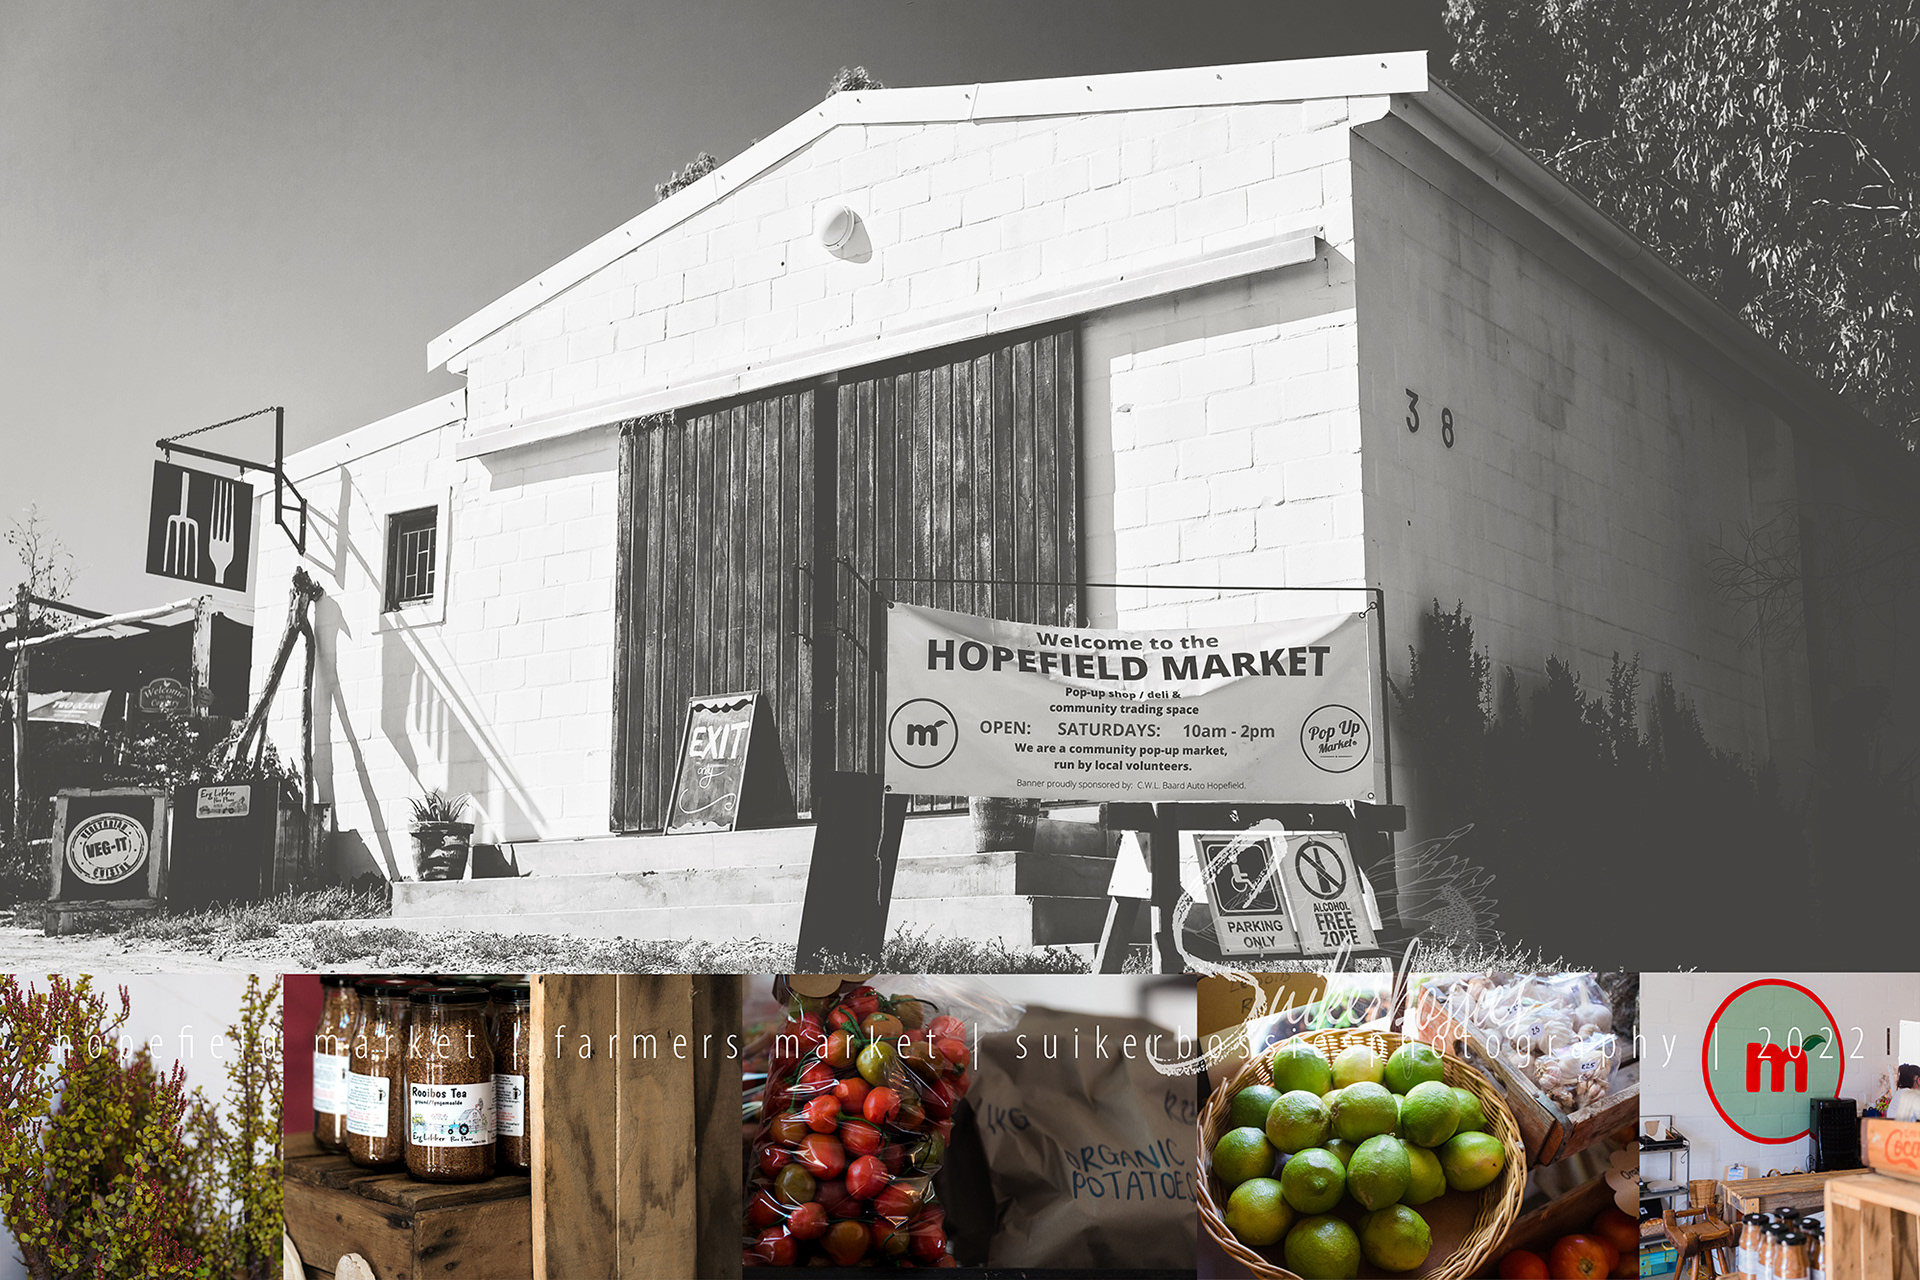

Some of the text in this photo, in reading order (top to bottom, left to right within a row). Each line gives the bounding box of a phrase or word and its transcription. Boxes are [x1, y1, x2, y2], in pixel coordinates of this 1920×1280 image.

[1036, 632, 1219, 650] Welcome to the
[927, 639, 1331, 681] HOPEFIELD MARKET
[144, 686, 186, 698] Welcome
[1065, 687, 1105, 699] Pop-up
[1108, 690, 1136, 700] shop
[1147, 690, 1169, 699] deli
[1172, 690, 1181, 699] &
[1050, 703, 1199, 716] community trading space
[980, 720, 1031, 735] OPEN:
[1058, 722, 1161, 738] SATURDAYS:
[1183, 724, 1227, 738] 10am
[1240, 724, 1275, 741] 2pm
[1308, 720, 1360, 742] Pop Up
[689, 720, 750, 760] EXIT
[1015, 743, 1228, 757] We are a community pop-up market,
[1054, 760, 1192, 772] run by local volunteers.
[1016, 779, 1246, 791] Banner proudly sponsored by: C.W.L. Baard Auto Hopefield.
[86, 836, 128, 858] VEG-IT
[92, 862, 132, 878] CUISINE
[1313, 901, 1350, 912] ALCOHOL
[1227, 919, 1284, 933] PARKING
[1315, 911, 1356, 931] FREE
[1243, 936, 1277, 948] ONLY
[1319, 930, 1361, 948] ZONE
[412, 1086, 467, 1098] Rooibos Tea
[1065, 1138, 1185, 1173] ORGANIC
